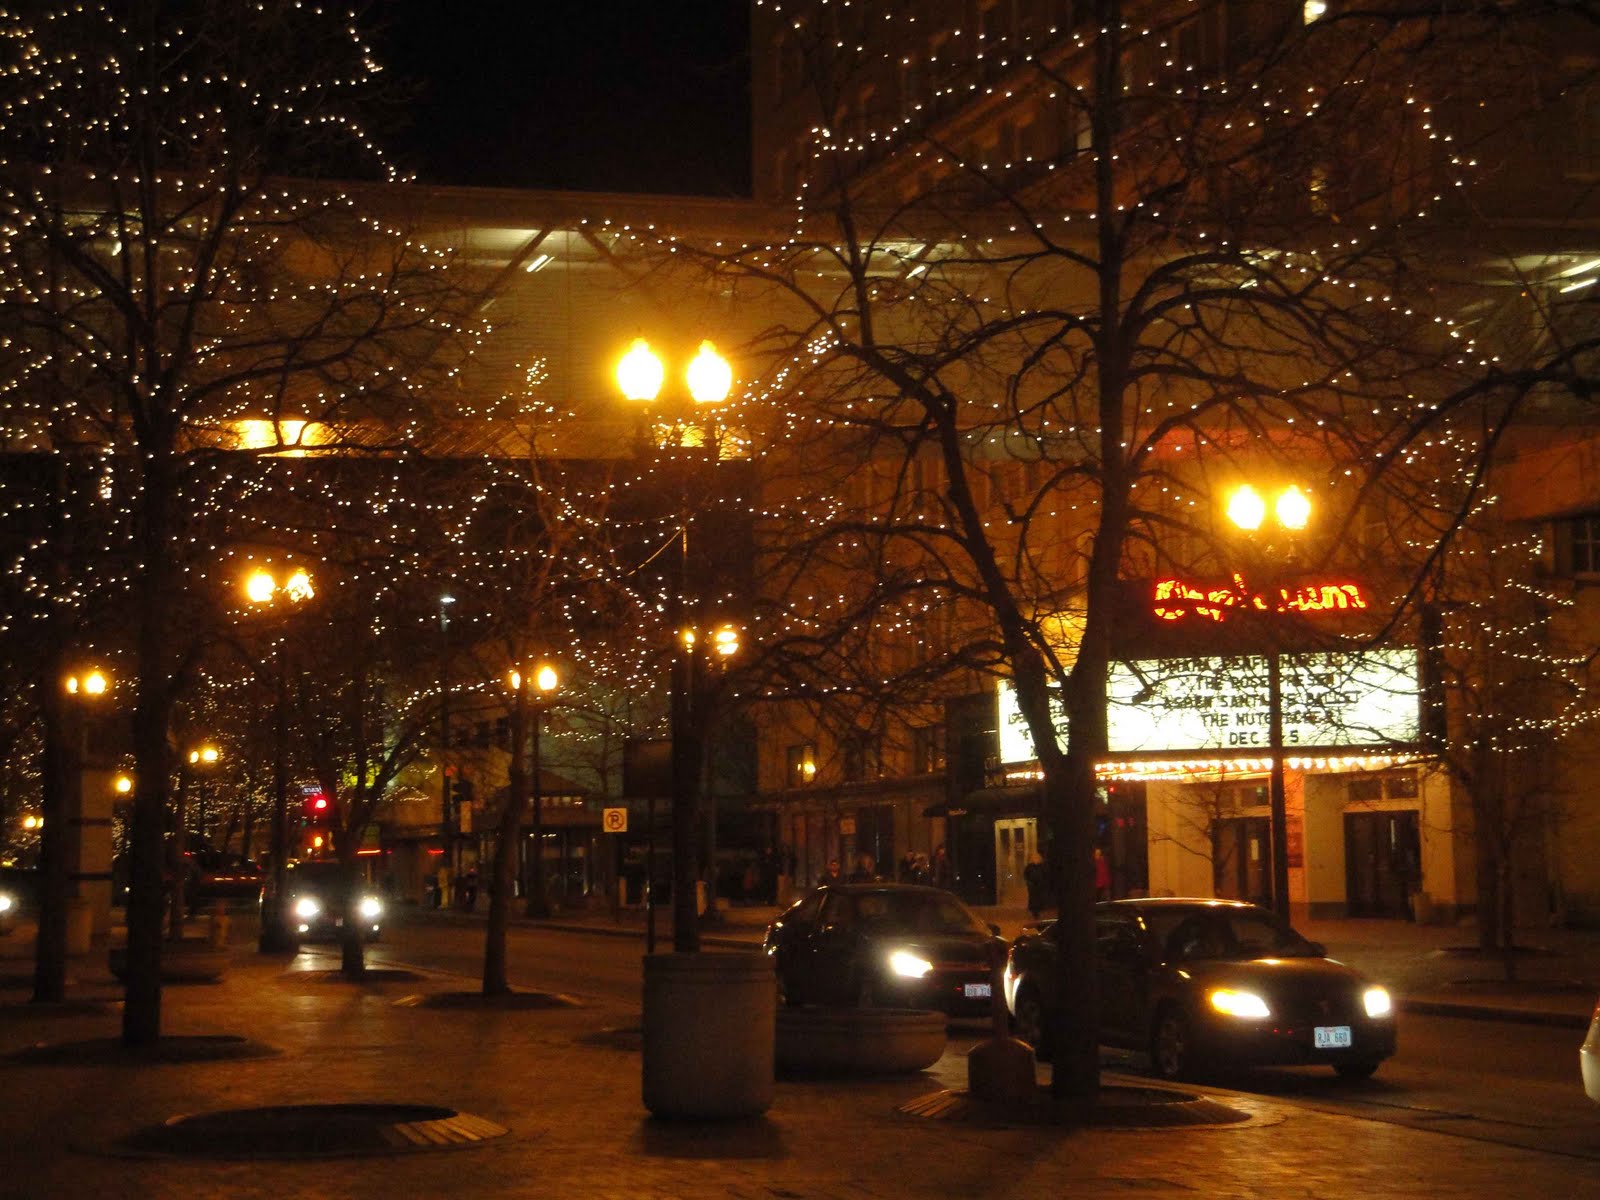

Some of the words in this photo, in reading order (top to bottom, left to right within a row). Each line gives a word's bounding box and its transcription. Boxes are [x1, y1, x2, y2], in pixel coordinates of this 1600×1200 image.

[1200, 712, 1229, 727] THE
[1236, 710, 1334, 726] NUTCACKER
[1229, 731, 1259, 745] DEC
